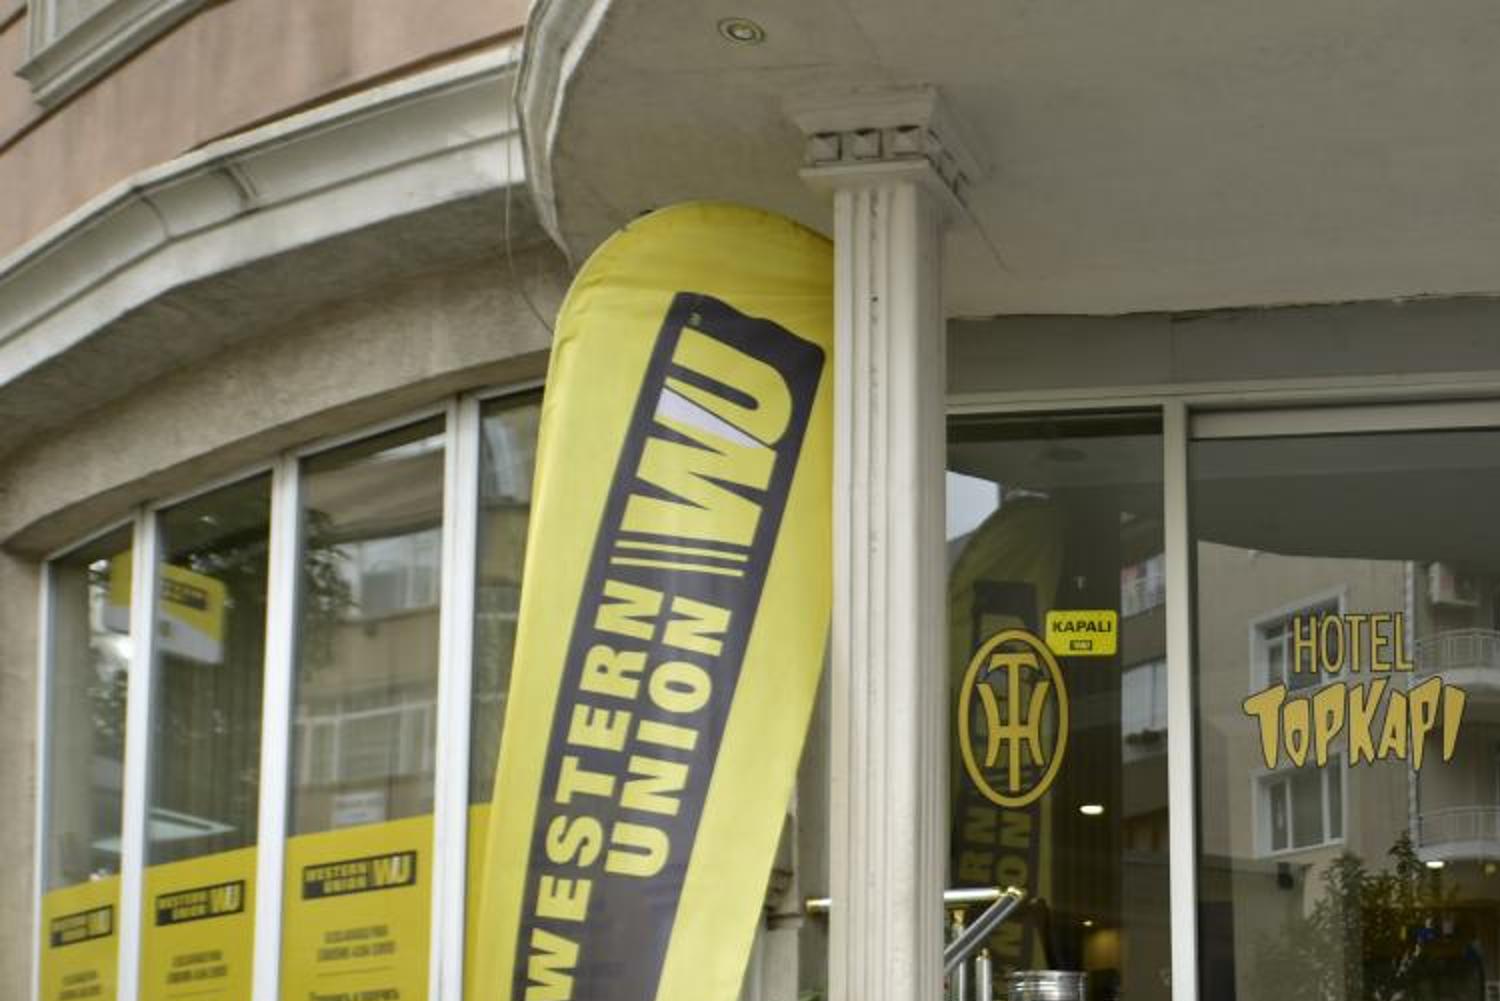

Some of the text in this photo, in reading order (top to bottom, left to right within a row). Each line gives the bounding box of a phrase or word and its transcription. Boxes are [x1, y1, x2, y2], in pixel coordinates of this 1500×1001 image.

[619, 326, 793, 546] WU
[1052, 620, 1112, 633] KAPALI
[1291, 612, 1415, 673] HOTEL
[604, 596, 732, 878] UNION
